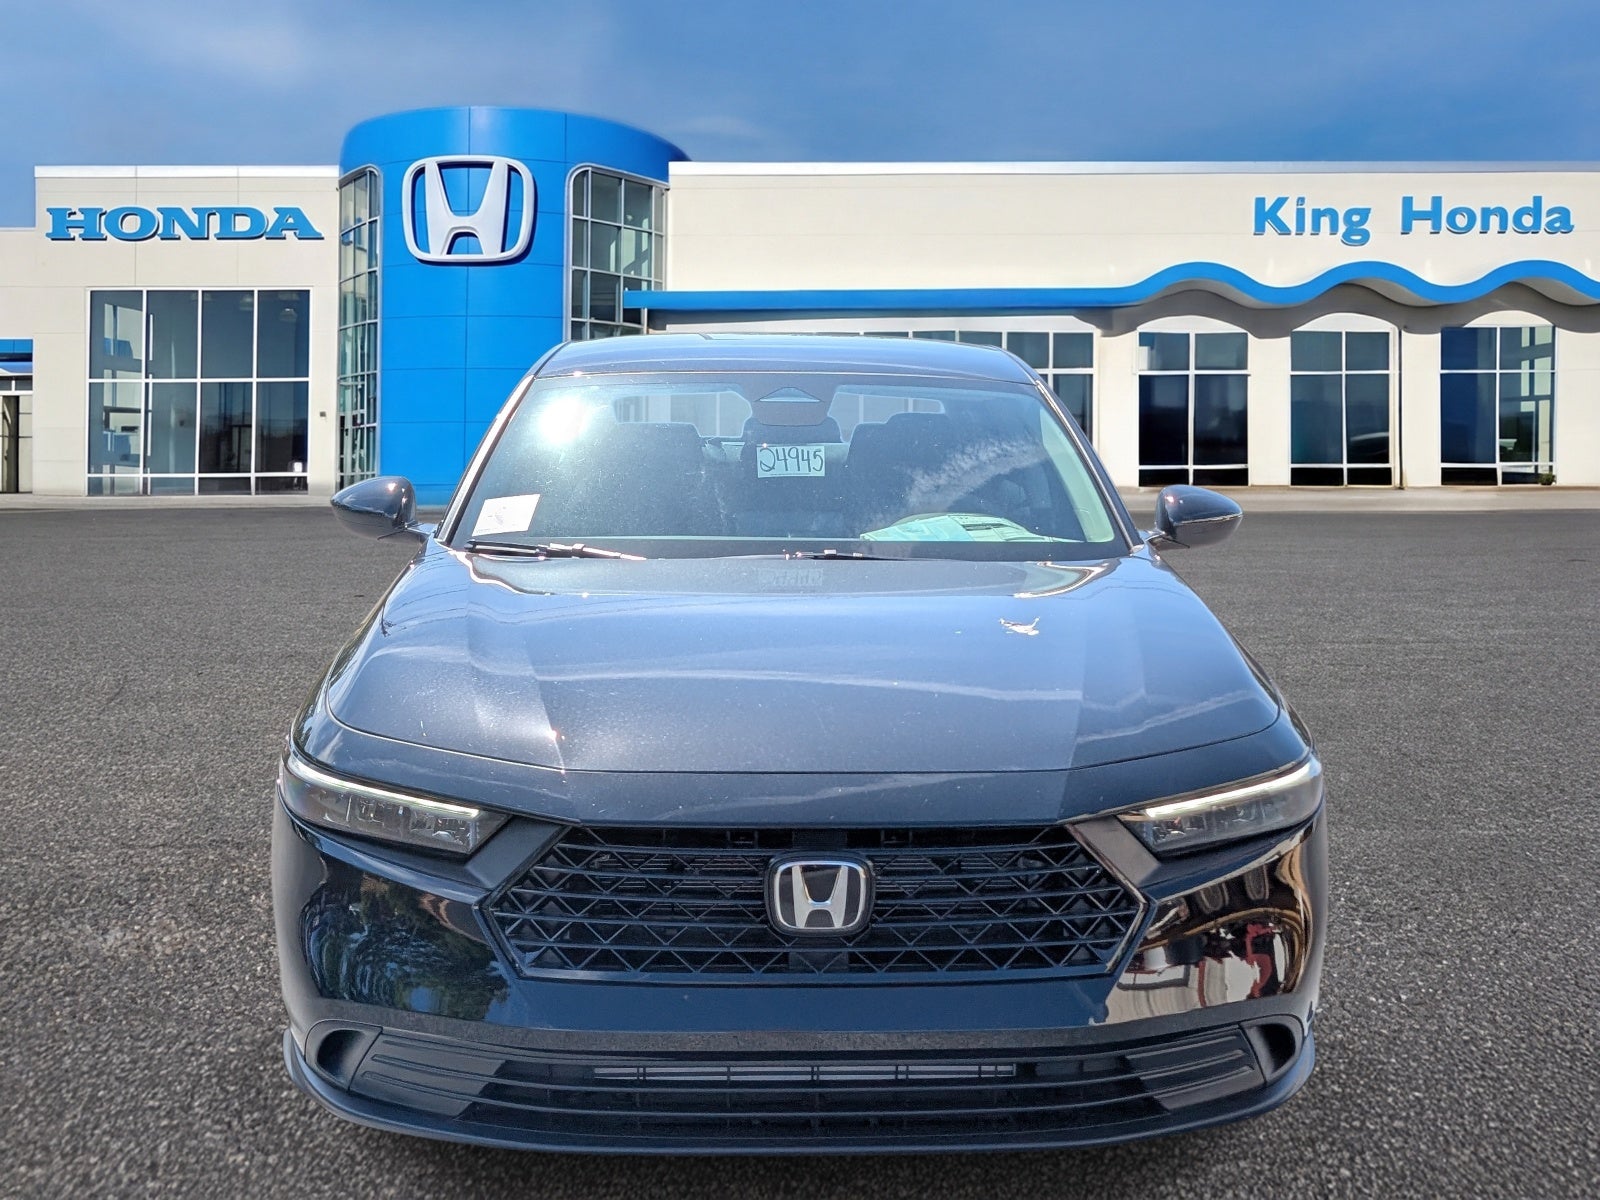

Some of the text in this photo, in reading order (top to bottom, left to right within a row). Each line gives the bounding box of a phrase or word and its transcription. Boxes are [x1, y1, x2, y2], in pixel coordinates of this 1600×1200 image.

[45, 206, 325, 241] HONDA
[1253, 195, 1575, 246] King Honda
[759, 446, 824, 473] 24945
